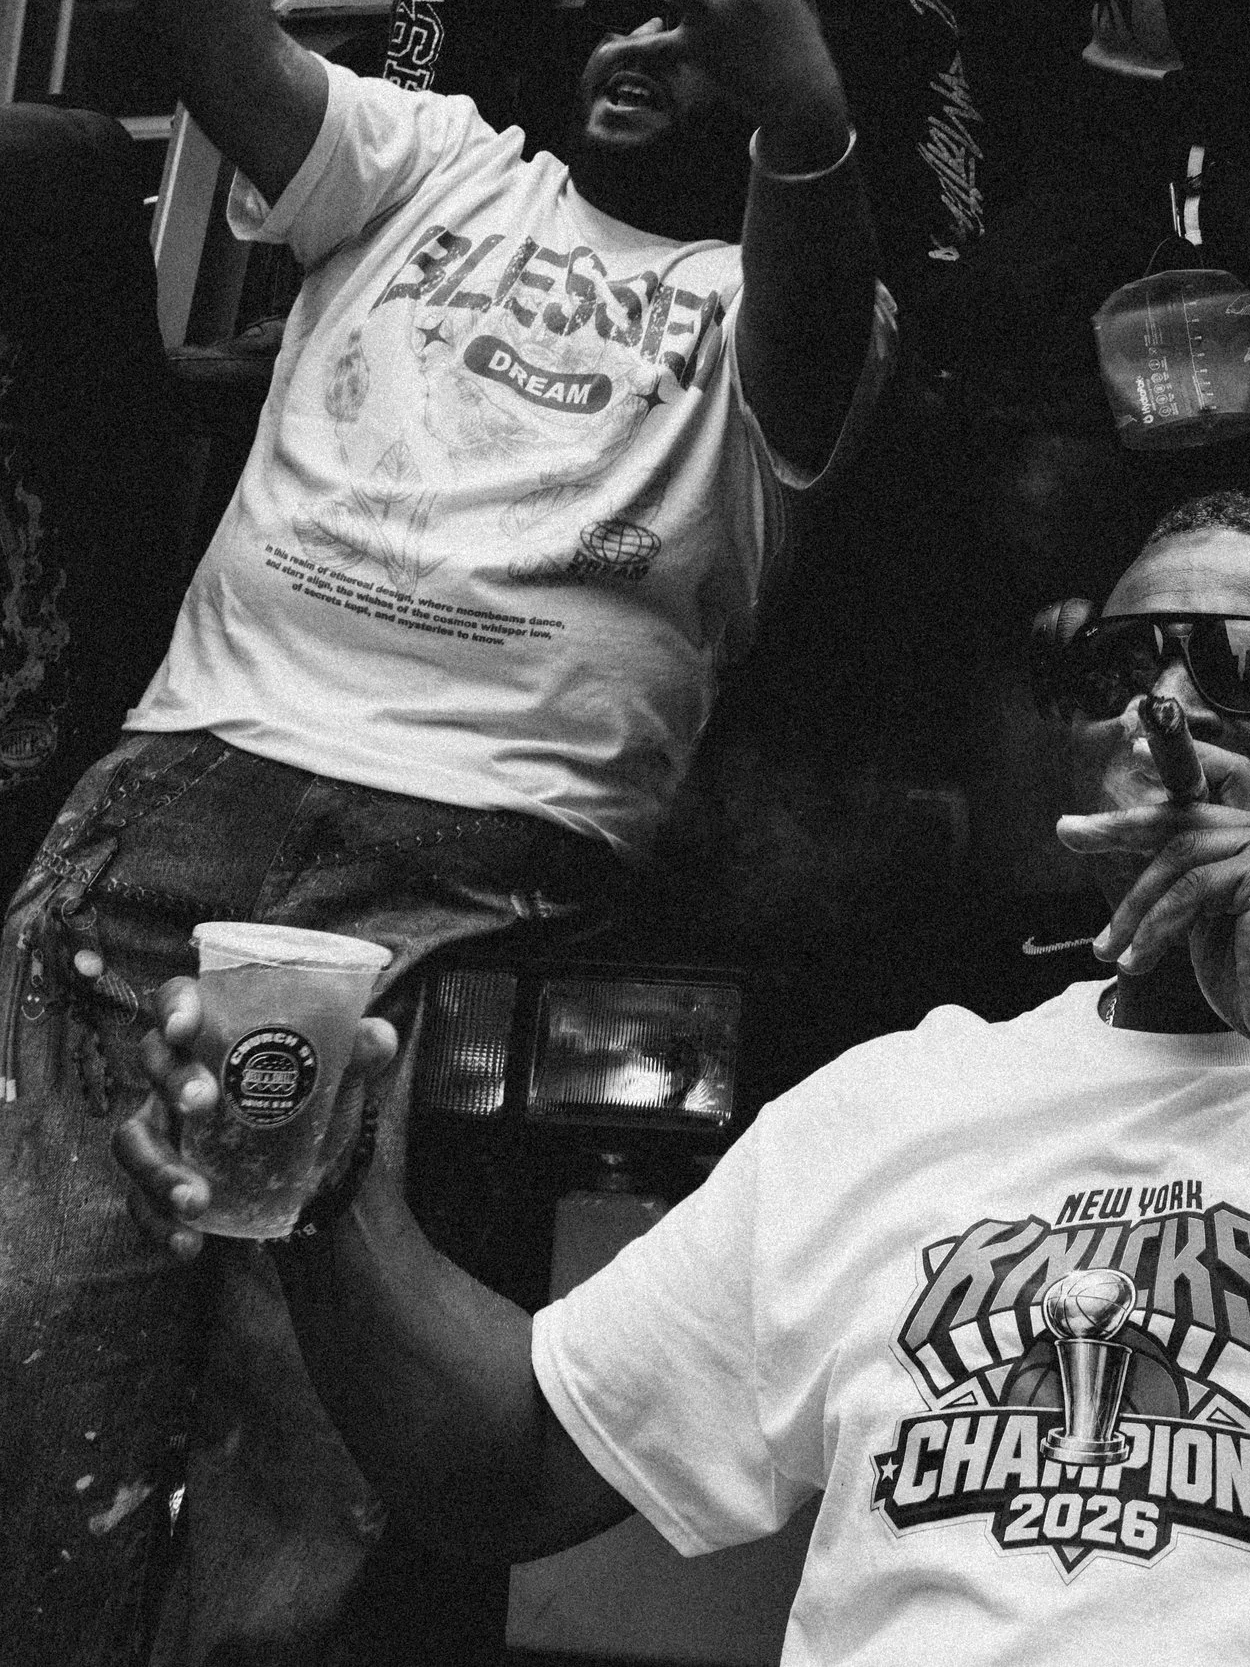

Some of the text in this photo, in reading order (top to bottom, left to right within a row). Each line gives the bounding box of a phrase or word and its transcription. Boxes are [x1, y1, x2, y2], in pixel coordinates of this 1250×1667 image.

[487, 348, 593, 406] DREAM
[265, 558, 553, 641] and stars align, the wishes of the cosmos whisper low,
[273, 546, 289, 561] this
[289, 554, 316, 572] realm
[317, 565, 329, 575] of
[329, 570, 375, 591] ethereal
[375, 585, 415, 605] design,
[418, 596, 454, 613] where
[456, 606, 527, 625] moonbeams
[528, 616, 566, 630] dance,
[291, 583, 505, 646] of secrets kept, and mysteries to know.
[1053, 1179, 1203, 1226] NEW YORK
[1002, 1492, 1160, 1553] 2026
